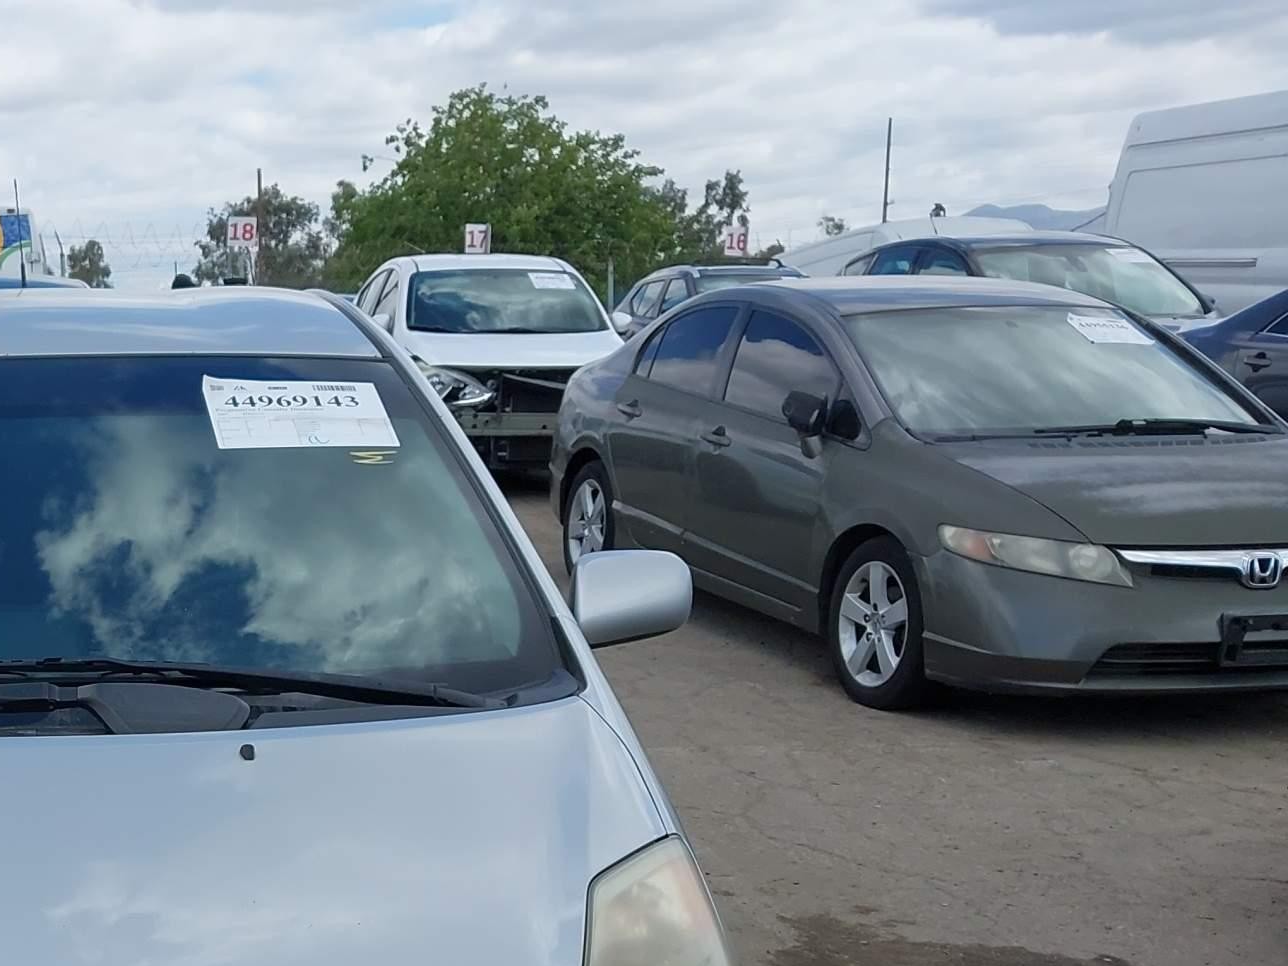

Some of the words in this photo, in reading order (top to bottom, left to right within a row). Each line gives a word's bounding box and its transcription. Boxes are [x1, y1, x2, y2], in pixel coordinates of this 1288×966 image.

[229, 223, 254, 241] 18
[468, 230, 487, 248] 17
[224, 394, 359, 407] 44969143
